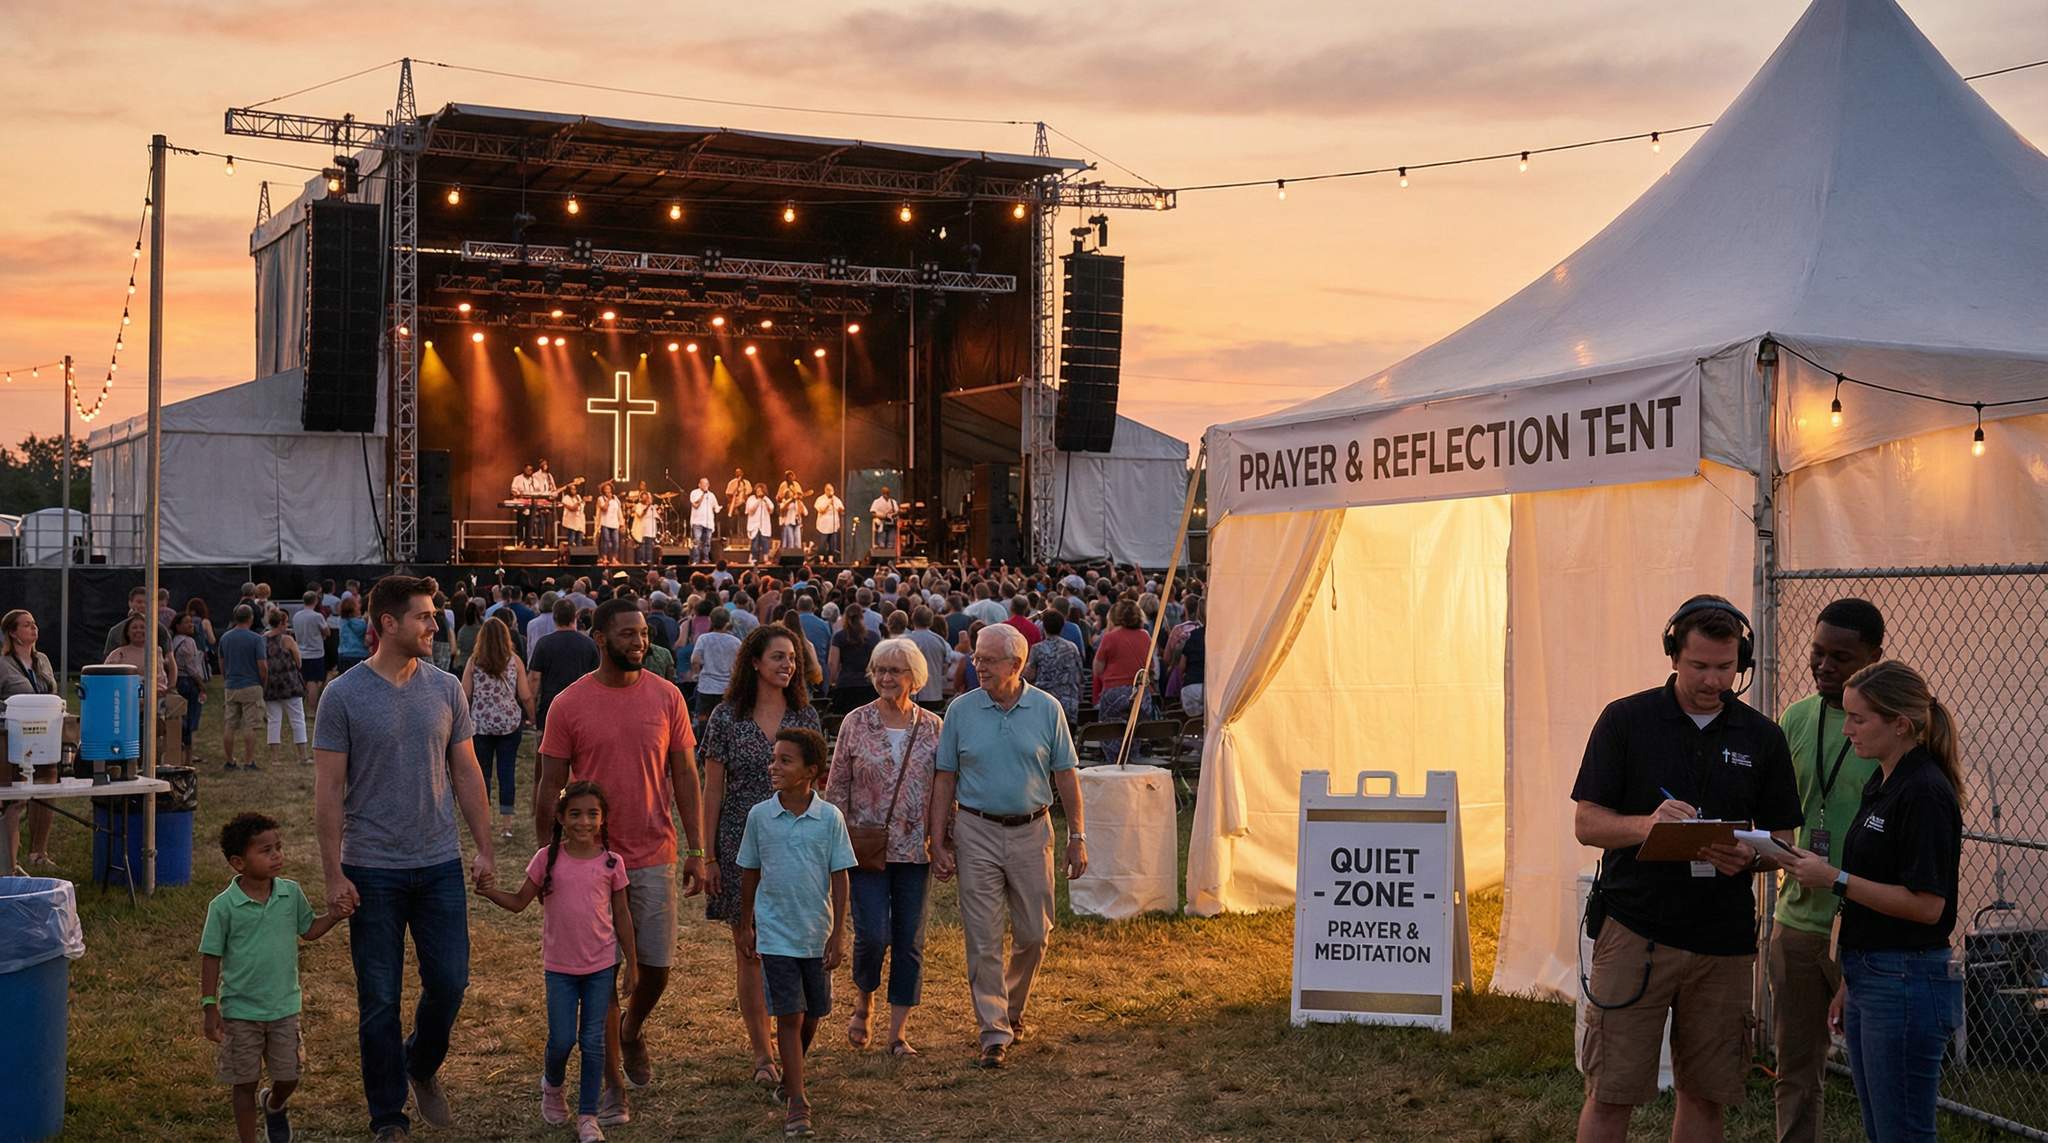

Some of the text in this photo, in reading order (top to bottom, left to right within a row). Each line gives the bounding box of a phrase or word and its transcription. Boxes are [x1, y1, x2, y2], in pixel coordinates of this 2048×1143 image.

[1239, 395, 1682, 493] PRAYER & REFLECTION TENT
[1330, 847, 1420, 875] QUIET
[1333, 880, 1415, 908] ZONE
[1327, 919, 1420, 940] PRAYER &
[1314, 942, 1431, 964] MEDITATION
